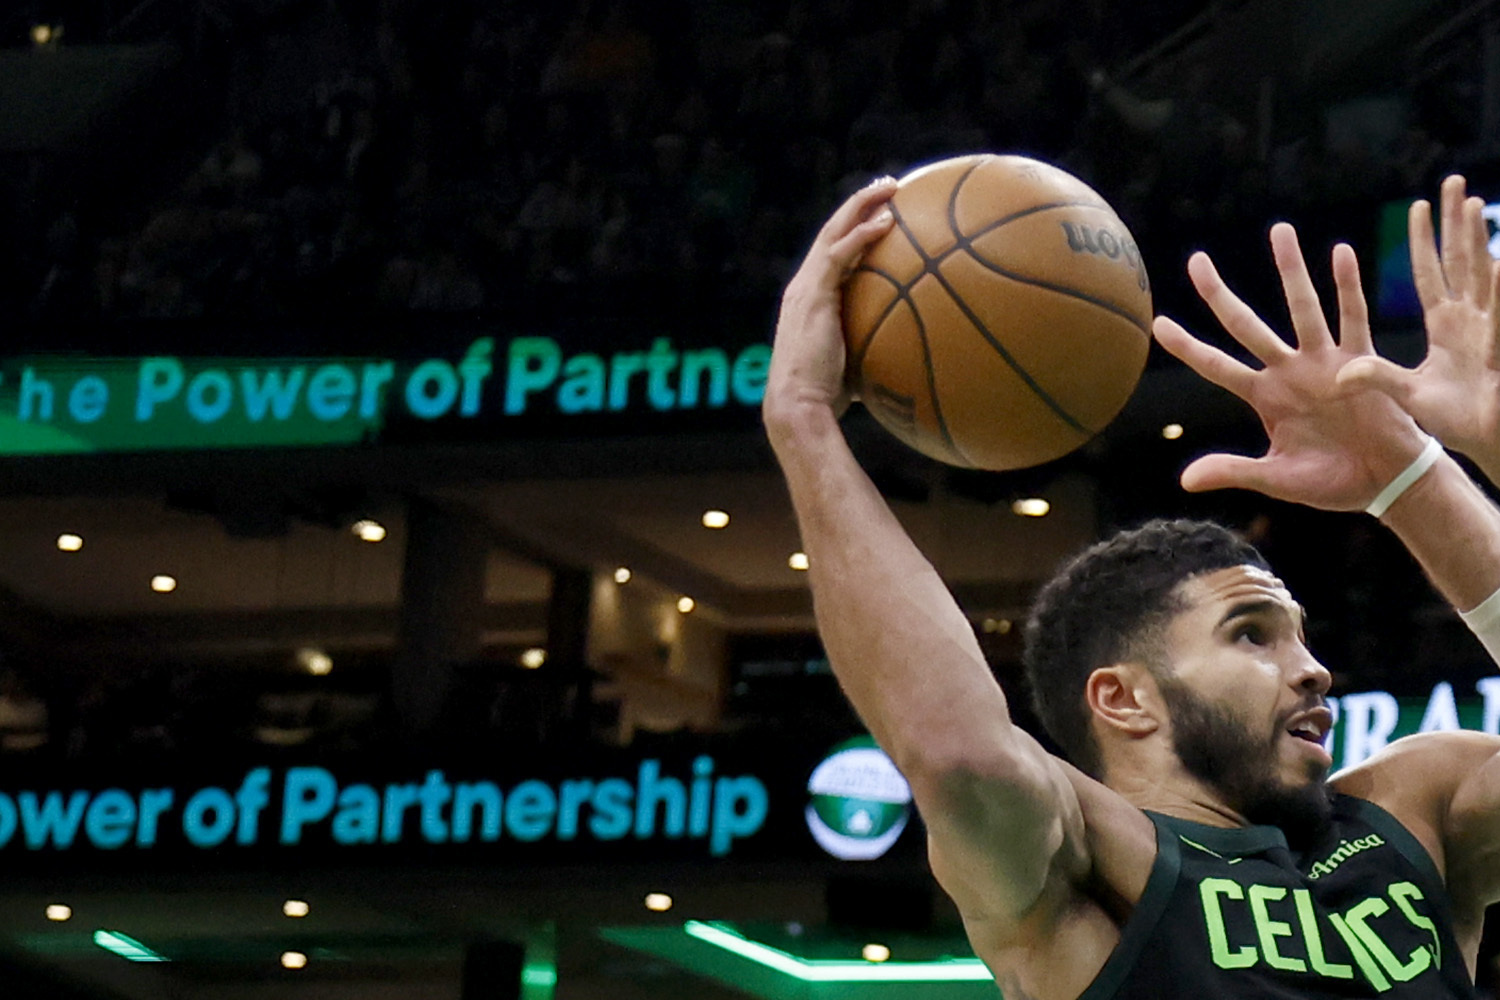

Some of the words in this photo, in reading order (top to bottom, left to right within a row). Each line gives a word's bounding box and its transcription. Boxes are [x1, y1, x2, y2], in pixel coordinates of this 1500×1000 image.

[0, 364, 109, 424] he
[135, 356, 396, 424] Power
[405, 336, 496, 419] of
[504, 335, 774, 416] Partne
[182, 766, 272, 848] of
[279, 755, 768, 856] Partnership
[1308, 833, 1385, 879] Amica
[1199, 877, 1442, 993] CELICS
